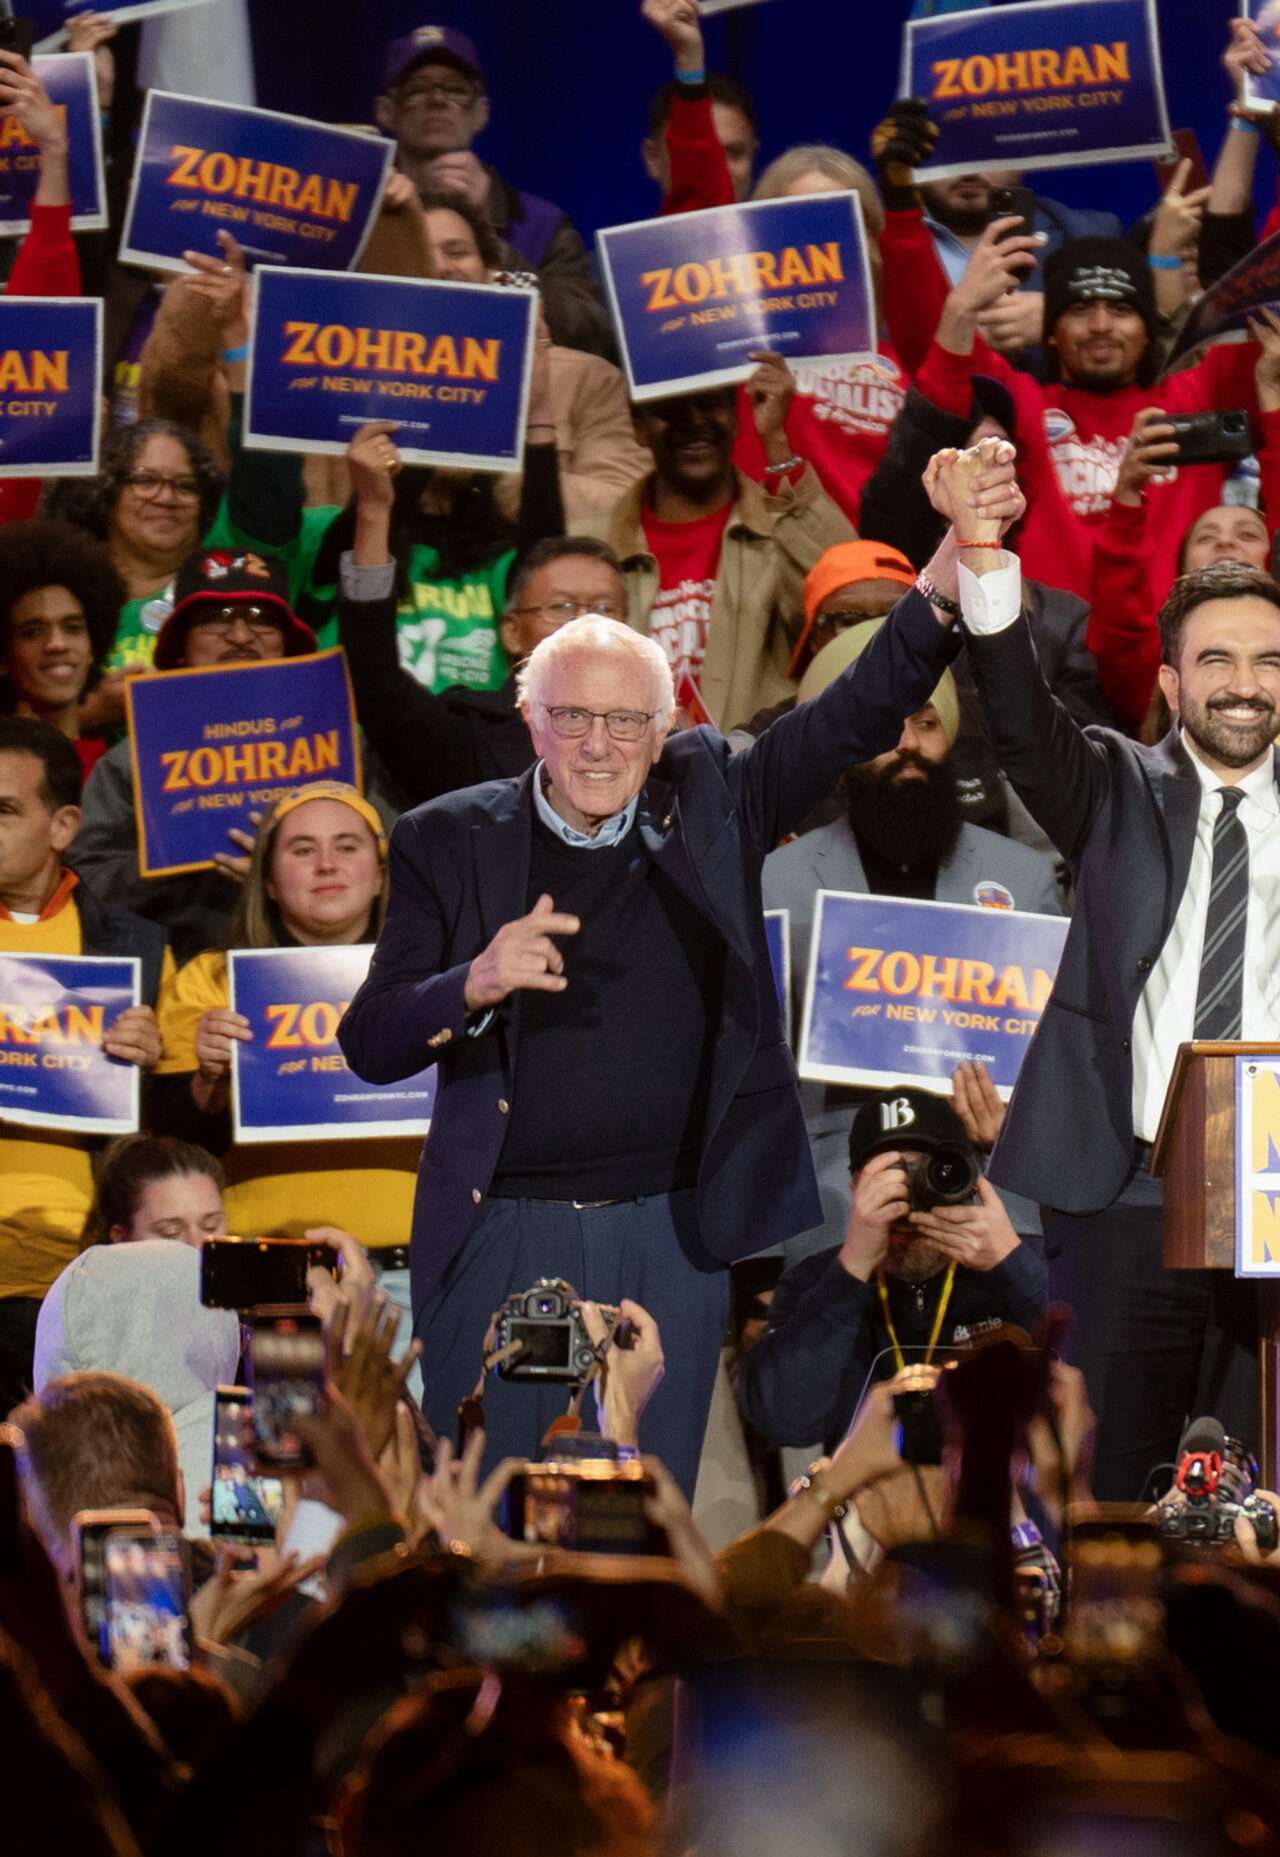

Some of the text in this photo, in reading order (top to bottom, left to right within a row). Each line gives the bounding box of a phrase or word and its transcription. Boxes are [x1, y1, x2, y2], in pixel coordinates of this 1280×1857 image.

[932, 41, 1131, 101] ZOHRAN
[970, 100, 1017, 118] NEW
[1023, 94, 1074, 113] YORK
[1077, 89, 1124, 107] CITY
[165, 144, 360, 223] ZOHRAN
[202, 199, 249, 222] NEW
[252, 211, 297, 234] YORK
[299, 222, 338, 242] CITY
[640, 242, 845, 313] ZOHRAN
[690, 305, 737, 326] NEW
[797, 291, 839, 310] CITY
[281, 320, 502, 382] ZOHRAN
[320, 375, 375, 393] NEW
[377, 380, 433, 399] YORK
[436, 385, 487, 405] CITY
[7, 399, 57, 417] CITY
[204, 718, 276, 739] HINDUS
[160, 730, 340, 793] ZOHRAN
[197, 792, 245, 810] NEW
[851, 1003, 1040, 1036] FOR NEW YORK CIT
[42, 1054, 92, 1071] CITY
